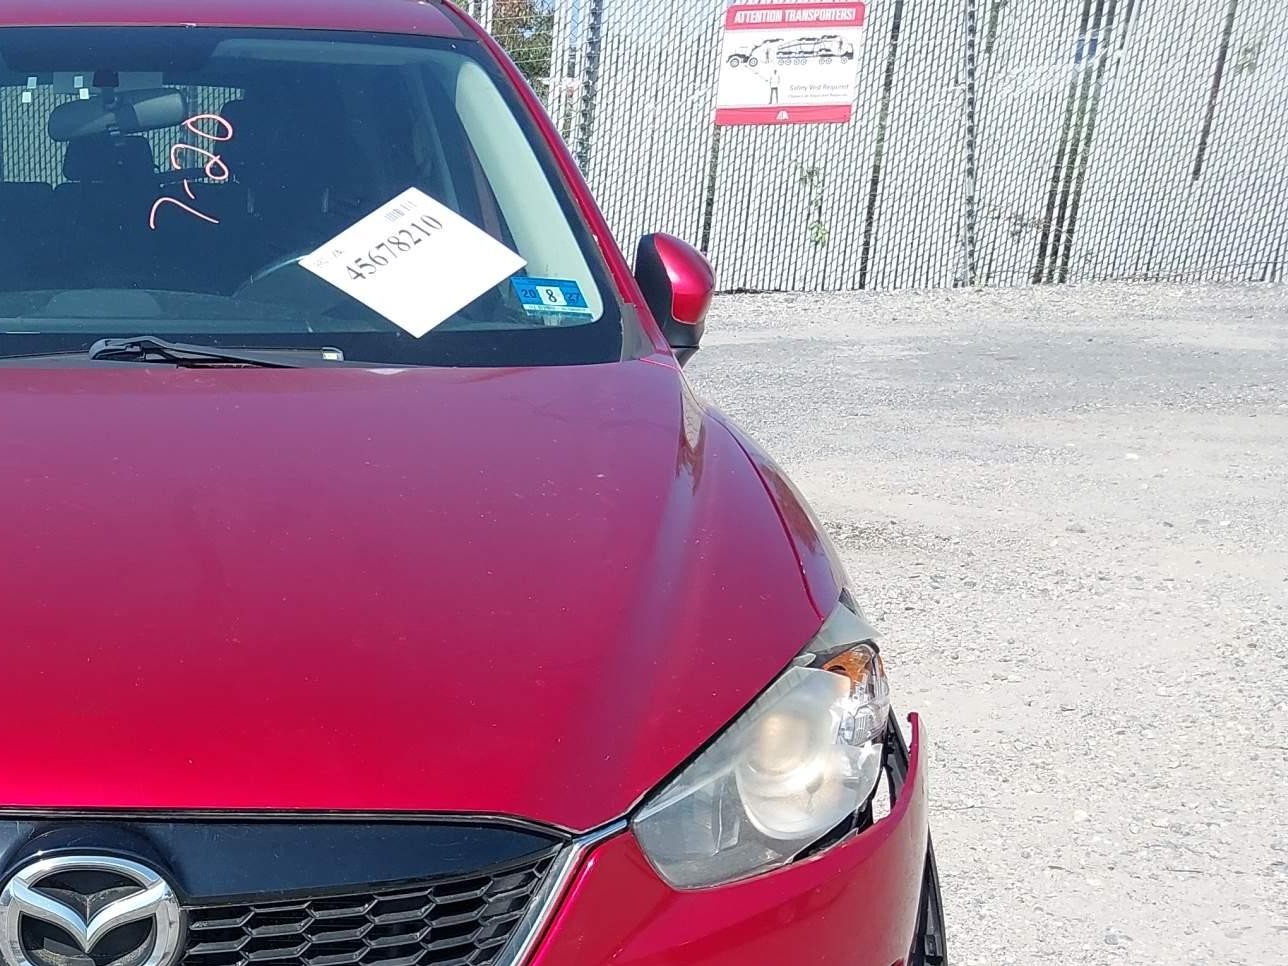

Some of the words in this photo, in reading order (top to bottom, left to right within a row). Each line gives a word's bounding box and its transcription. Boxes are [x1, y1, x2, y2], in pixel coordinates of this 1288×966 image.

[734, 10, 782, 24] ATTENTION
[784, 8, 856, 22] TRANSPORTERS!
[346, 214, 443, 280] 45678210
[520, 288, 537, 299] 20
[545, 289, 558, 303] 8
